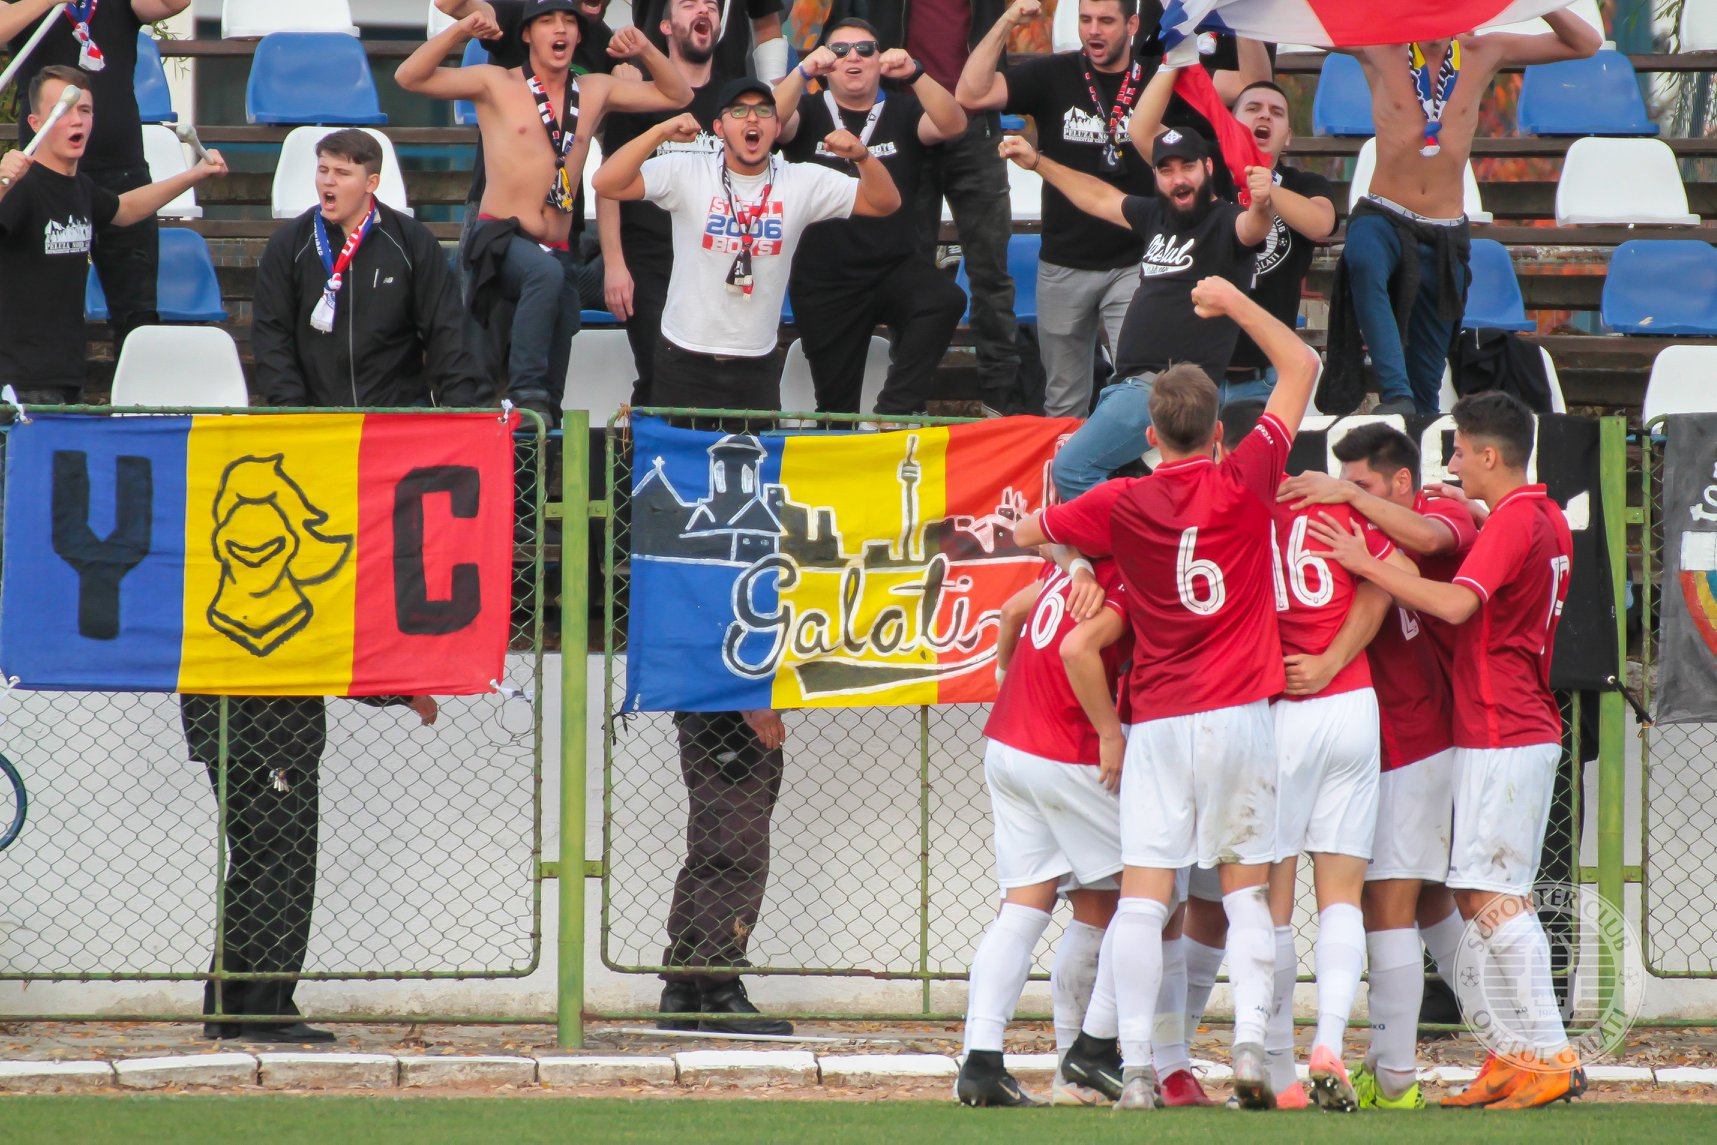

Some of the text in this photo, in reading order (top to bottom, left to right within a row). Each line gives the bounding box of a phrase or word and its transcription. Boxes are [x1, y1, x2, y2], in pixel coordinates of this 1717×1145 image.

[1064, 128, 1093, 139] PELUZA
[706, 214, 782, 240] 2006
[711, 197, 782, 218] SEL
[51, 450, 482, 640] Y C
[1176, 526, 1227, 615] 6
[1270, 515, 1334, 612] 16
